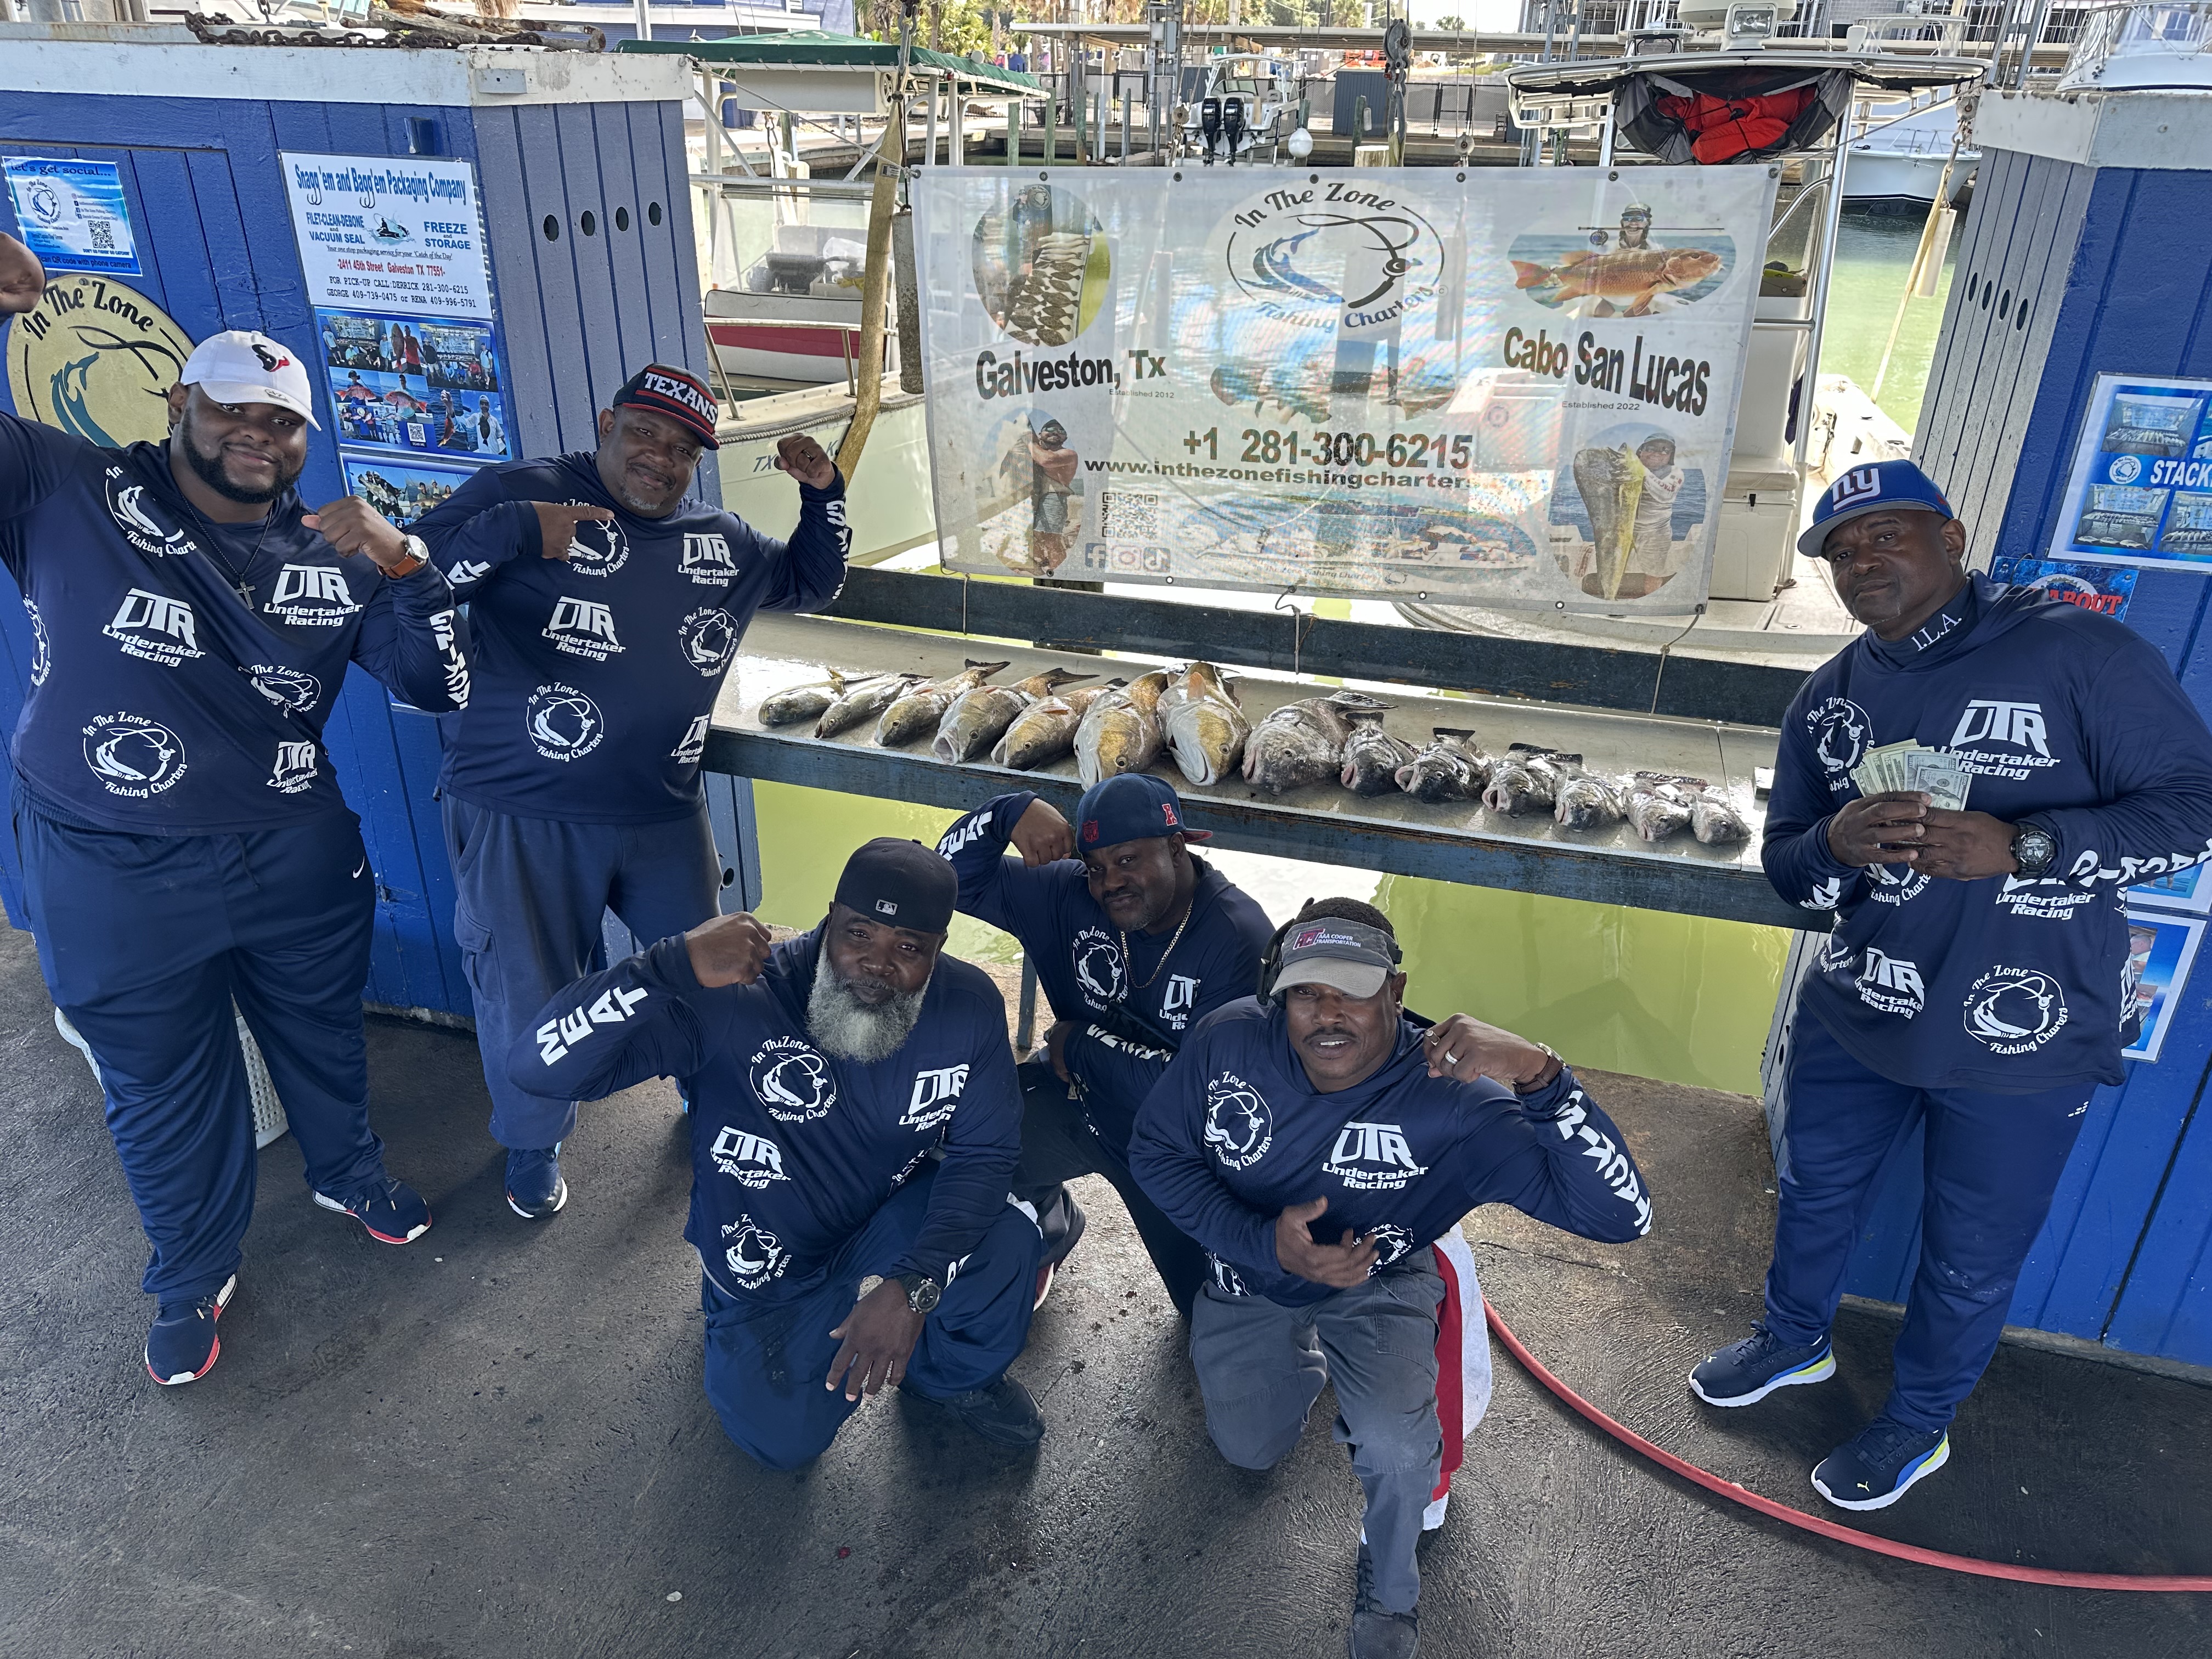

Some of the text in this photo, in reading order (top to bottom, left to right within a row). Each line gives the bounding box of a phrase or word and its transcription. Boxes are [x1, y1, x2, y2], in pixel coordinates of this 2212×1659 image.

[40, 165, 60, 175] get
[336, 167, 352, 191] and
[386, 169, 429, 203] Packaging
[429, 172, 466, 206] Company
[1234, 182, 1396, 229] In The Zone
[306, 212, 364, 228] FILET-CLEAN-DEBONE
[424, 221, 468, 234] FREEZE
[309, 231, 365, 244] VACUUM SEAL
[425, 238, 471, 250] STORAGE
[91, 259, 109, 268] phone
[353, 259, 365, 271] 45th
[366, 261, 383, 272] Street
[387, 262, 414, 274] Galveston
[416, 264, 425, 275] TX
[327, 289, 349, 297] GEORGE
[353, 290, 397, 301] 409-739-0475
[411, 295, 427, 304] RENA
[431, 296, 476, 307] 409-996-5791
[329, 276, 341, 284] FOR
[344, 278, 370, 286] PICK-UP
[422, 283, 469, 294] 281-300-6215
[22, 280, 154, 341] In The Zone
[1255, 286, 1434, 334] Fishing Charters
[976, 349, 1167, 399] Galveston, Tx
[1503, 326, 1711, 417] Cabo San Lucas
[644, 371, 719, 425] TEXANS
[1109, 388, 1153, 398] Established
[1562, 400, 1640, 411] Established 2022
[1183, 427, 1473, 471] +1 281-300-6215
[106, 465, 123, 479] In
[2150, 460, 2212, 487] STACK
[126, 531, 163, 557] Fishing
[682, 532, 736, 570] UTR
[573, 546, 630, 577] Fishing Charters
[678, 563, 740, 577] Undertaker
[272, 563, 356, 606] UTR
[692, 573, 729, 587] Racing
[111, 588, 198, 651] UTR
[263, 602, 363, 616] Undertaker
[284, 615, 344, 627] Racing
[549, 596, 619, 646] UTR
[678, 606, 717, 636] In The Zone
[102, 624, 206, 658] Undertaker
[541, 628, 626, 653] Undertaker
[1911, 613, 1962, 652] I.L.A.
[121, 641, 182, 667] Racing
[555, 642, 608, 662] Racing
[251, 664, 305, 679] The Zone
[700, 665, 721, 678] Fishing
[528, 681, 579, 706] In The Zone
[82, 711, 152, 737] In The Zone
[1807, 705, 1826, 724] The
[1950, 699, 2051, 758] UTR
[273, 740, 316, 780] UTR
[536, 733, 603, 762] Fishing Charters
[1939, 746, 2061, 768] Undertaker
[105, 763, 188, 799] Fishing Charters
[266, 769, 318, 789] Undertaker
[1959, 760, 2032, 781] Racing
[1901, 873, 1931, 902] Charte
[1996, 891, 2096, 905] Undertaker
[2011, 902, 2074, 921] Racing
[1316, 939, 1361, 947] TRANSPORTATION
[1864, 946, 1925, 1007] UTR
[1963, 964, 2029, 1007] In The Zone
[1083, 991, 1108, 1013] Fishing
[1860, 992, 1915, 1020] Racing
[537, 986, 649, 1066] MEAT
[1989, 1007, 2069, 1056] Fishing Charters
[752, 1051, 766, 1064] In
[782, 1036, 810, 1052] Zone
[1222, 1070, 1246, 1089] Zone
[768, 1093, 837, 1124] Fishing Charters
[713, 1125, 785, 1175] UTR
[1240, 1135, 1273, 1166] Charters
[1330, 1120, 1419, 1171] UTR
[710, 1146, 791, 1182] Undertaker
[718, 1164, 770, 1190] Racing
[1322, 1163, 1429, 1182] Undertaker
[1343, 1177, 1407, 1190] Racing
[737, 1272, 771, 1291] Fishing
